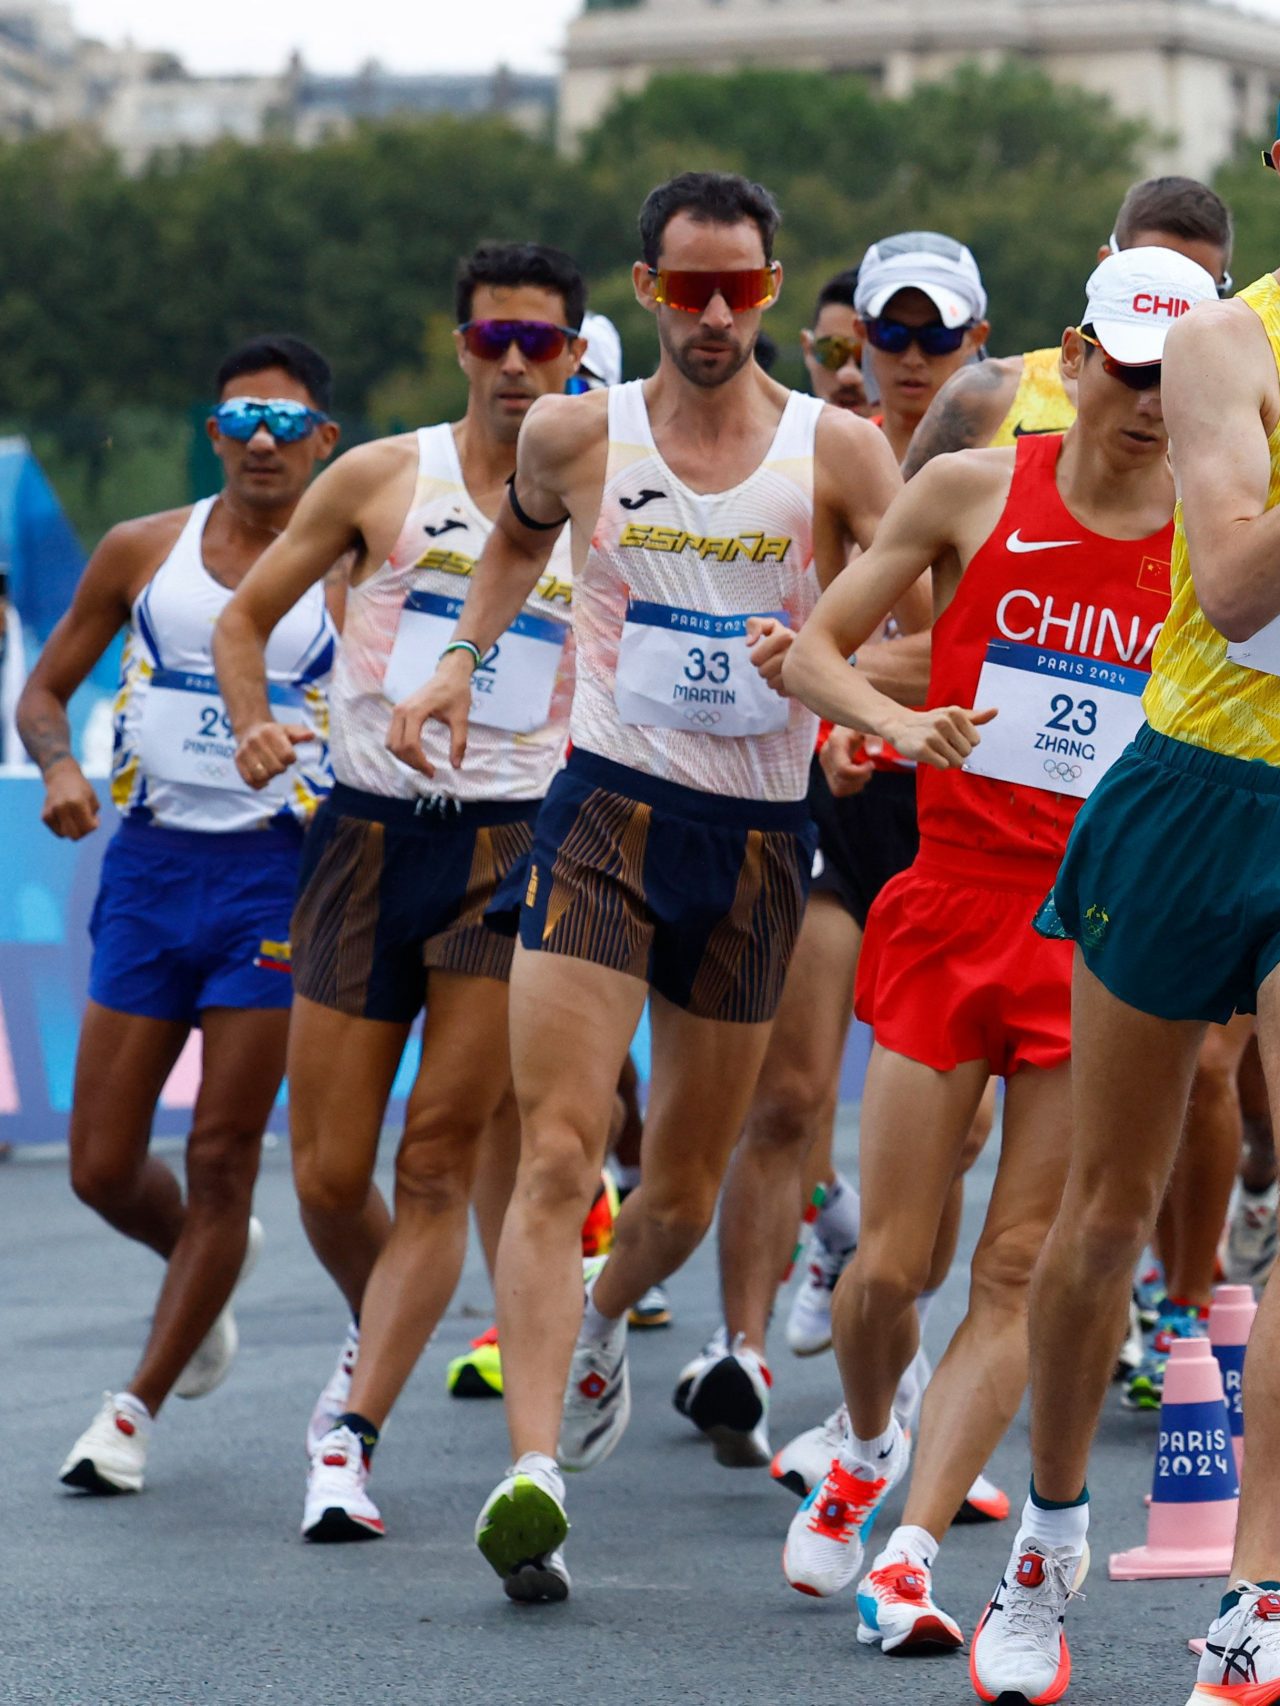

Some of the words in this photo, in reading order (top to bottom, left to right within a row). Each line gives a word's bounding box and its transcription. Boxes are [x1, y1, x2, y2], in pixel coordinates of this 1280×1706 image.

[619, 523, 792, 563] ESPAÑA
[683, 647, 730, 684] 33
[1088, 666, 1126, 686] 2024
[672, 684, 736, 705] MARTIN
[1044, 693, 1098, 736] 23
[1033, 732, 1096, 761] ZHANG
[1158, 1454, 1228, 1477] 2024
